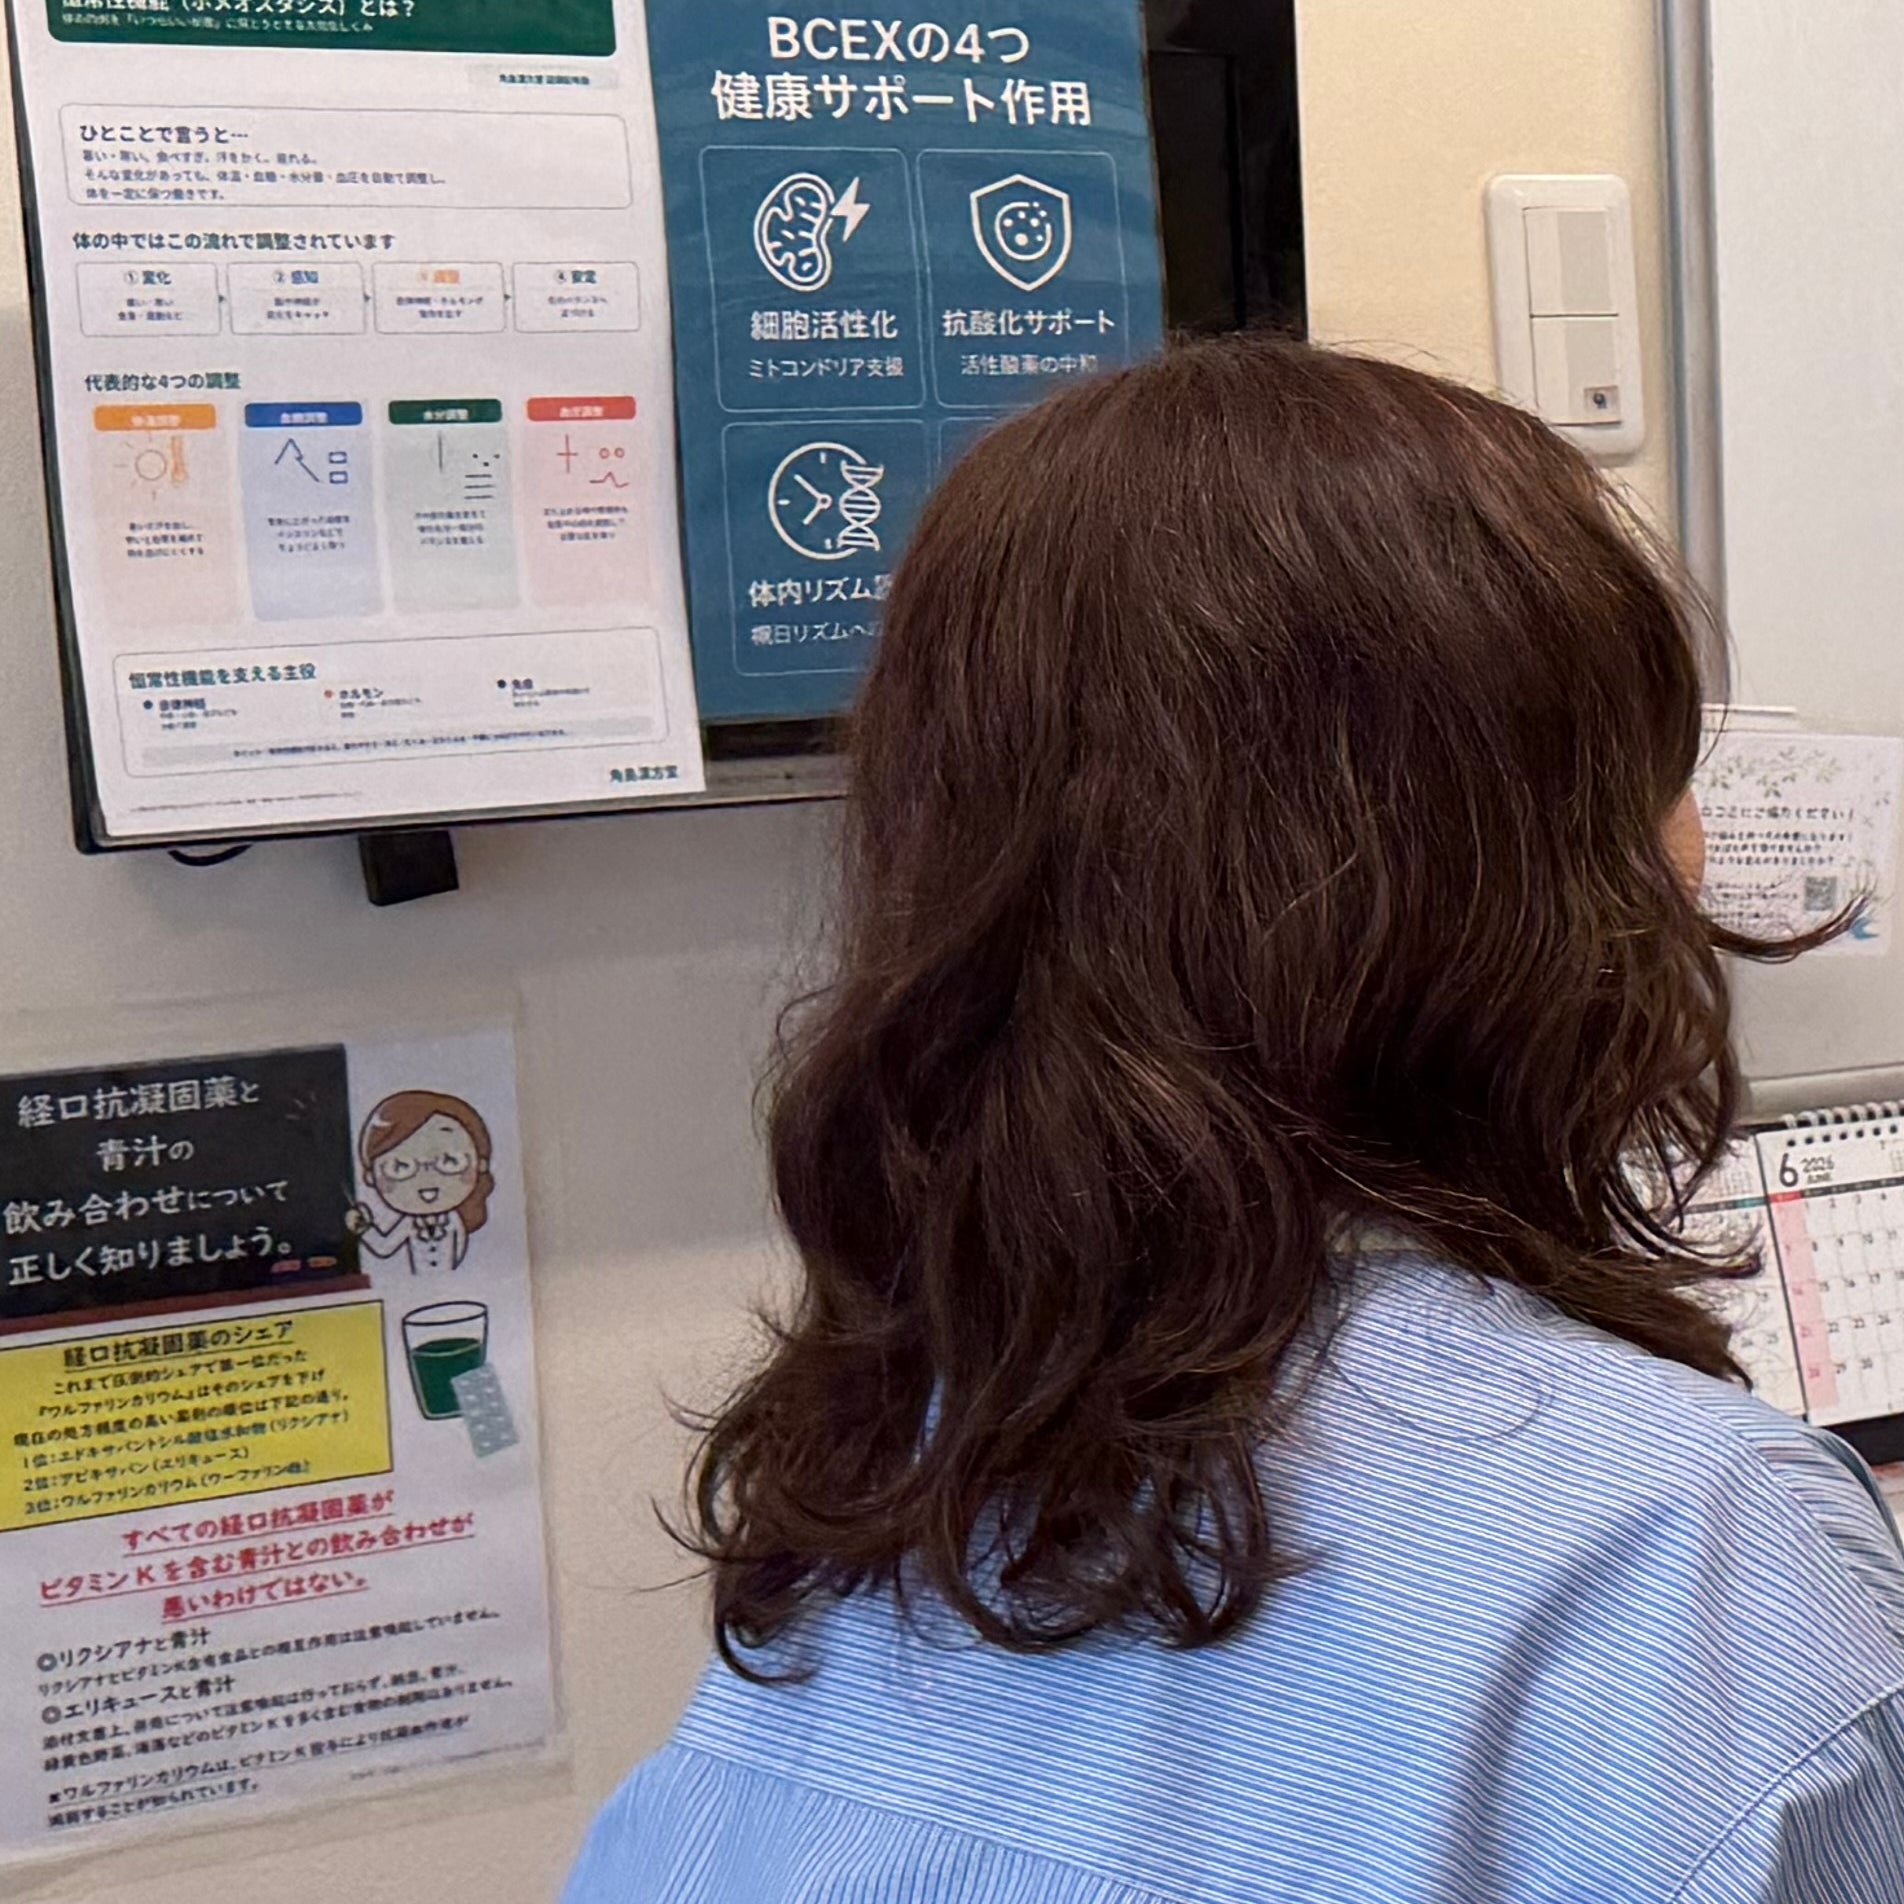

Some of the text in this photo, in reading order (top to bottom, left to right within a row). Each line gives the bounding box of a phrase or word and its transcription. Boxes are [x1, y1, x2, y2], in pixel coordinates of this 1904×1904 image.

[768, 16, 1031, 64] BCEXの4つ
[710, 70, 1092, 127] 健康サポート作用
[72, 232, 396, 250] 体の中ではこの流れで調整されています
[750, 309, 898, 341] 細胞活性化
[942, 308, 1116, 336] 抗酸化サポート
[85, 372, 241, 391] 代表的な4つの調整
[748, 355, 904, 379] ミトコンドリア支援
[751, 621, 883, 646] 概日リズムへ
[129, 663, 317, 689] 恒常性機能を支える主役
[18, 1076, 259, 1128] 経口抗凝固薬と
[96, 1135, 194, 1174] 青汁の
[1779, 1152, 1799, 1187] 6
[3, 1180, 289, 1235] 飲み合わせについて
[8, 1227, 294, 1287] 正しく知りましょう。
[64, 1320, 294, 1368] 経口抗凝固薬のシェア
[122, 1490, 395, 1552] すべての経口抗凝固薬が
[162, 1569, 368, 1619] 悪いわけではない。
